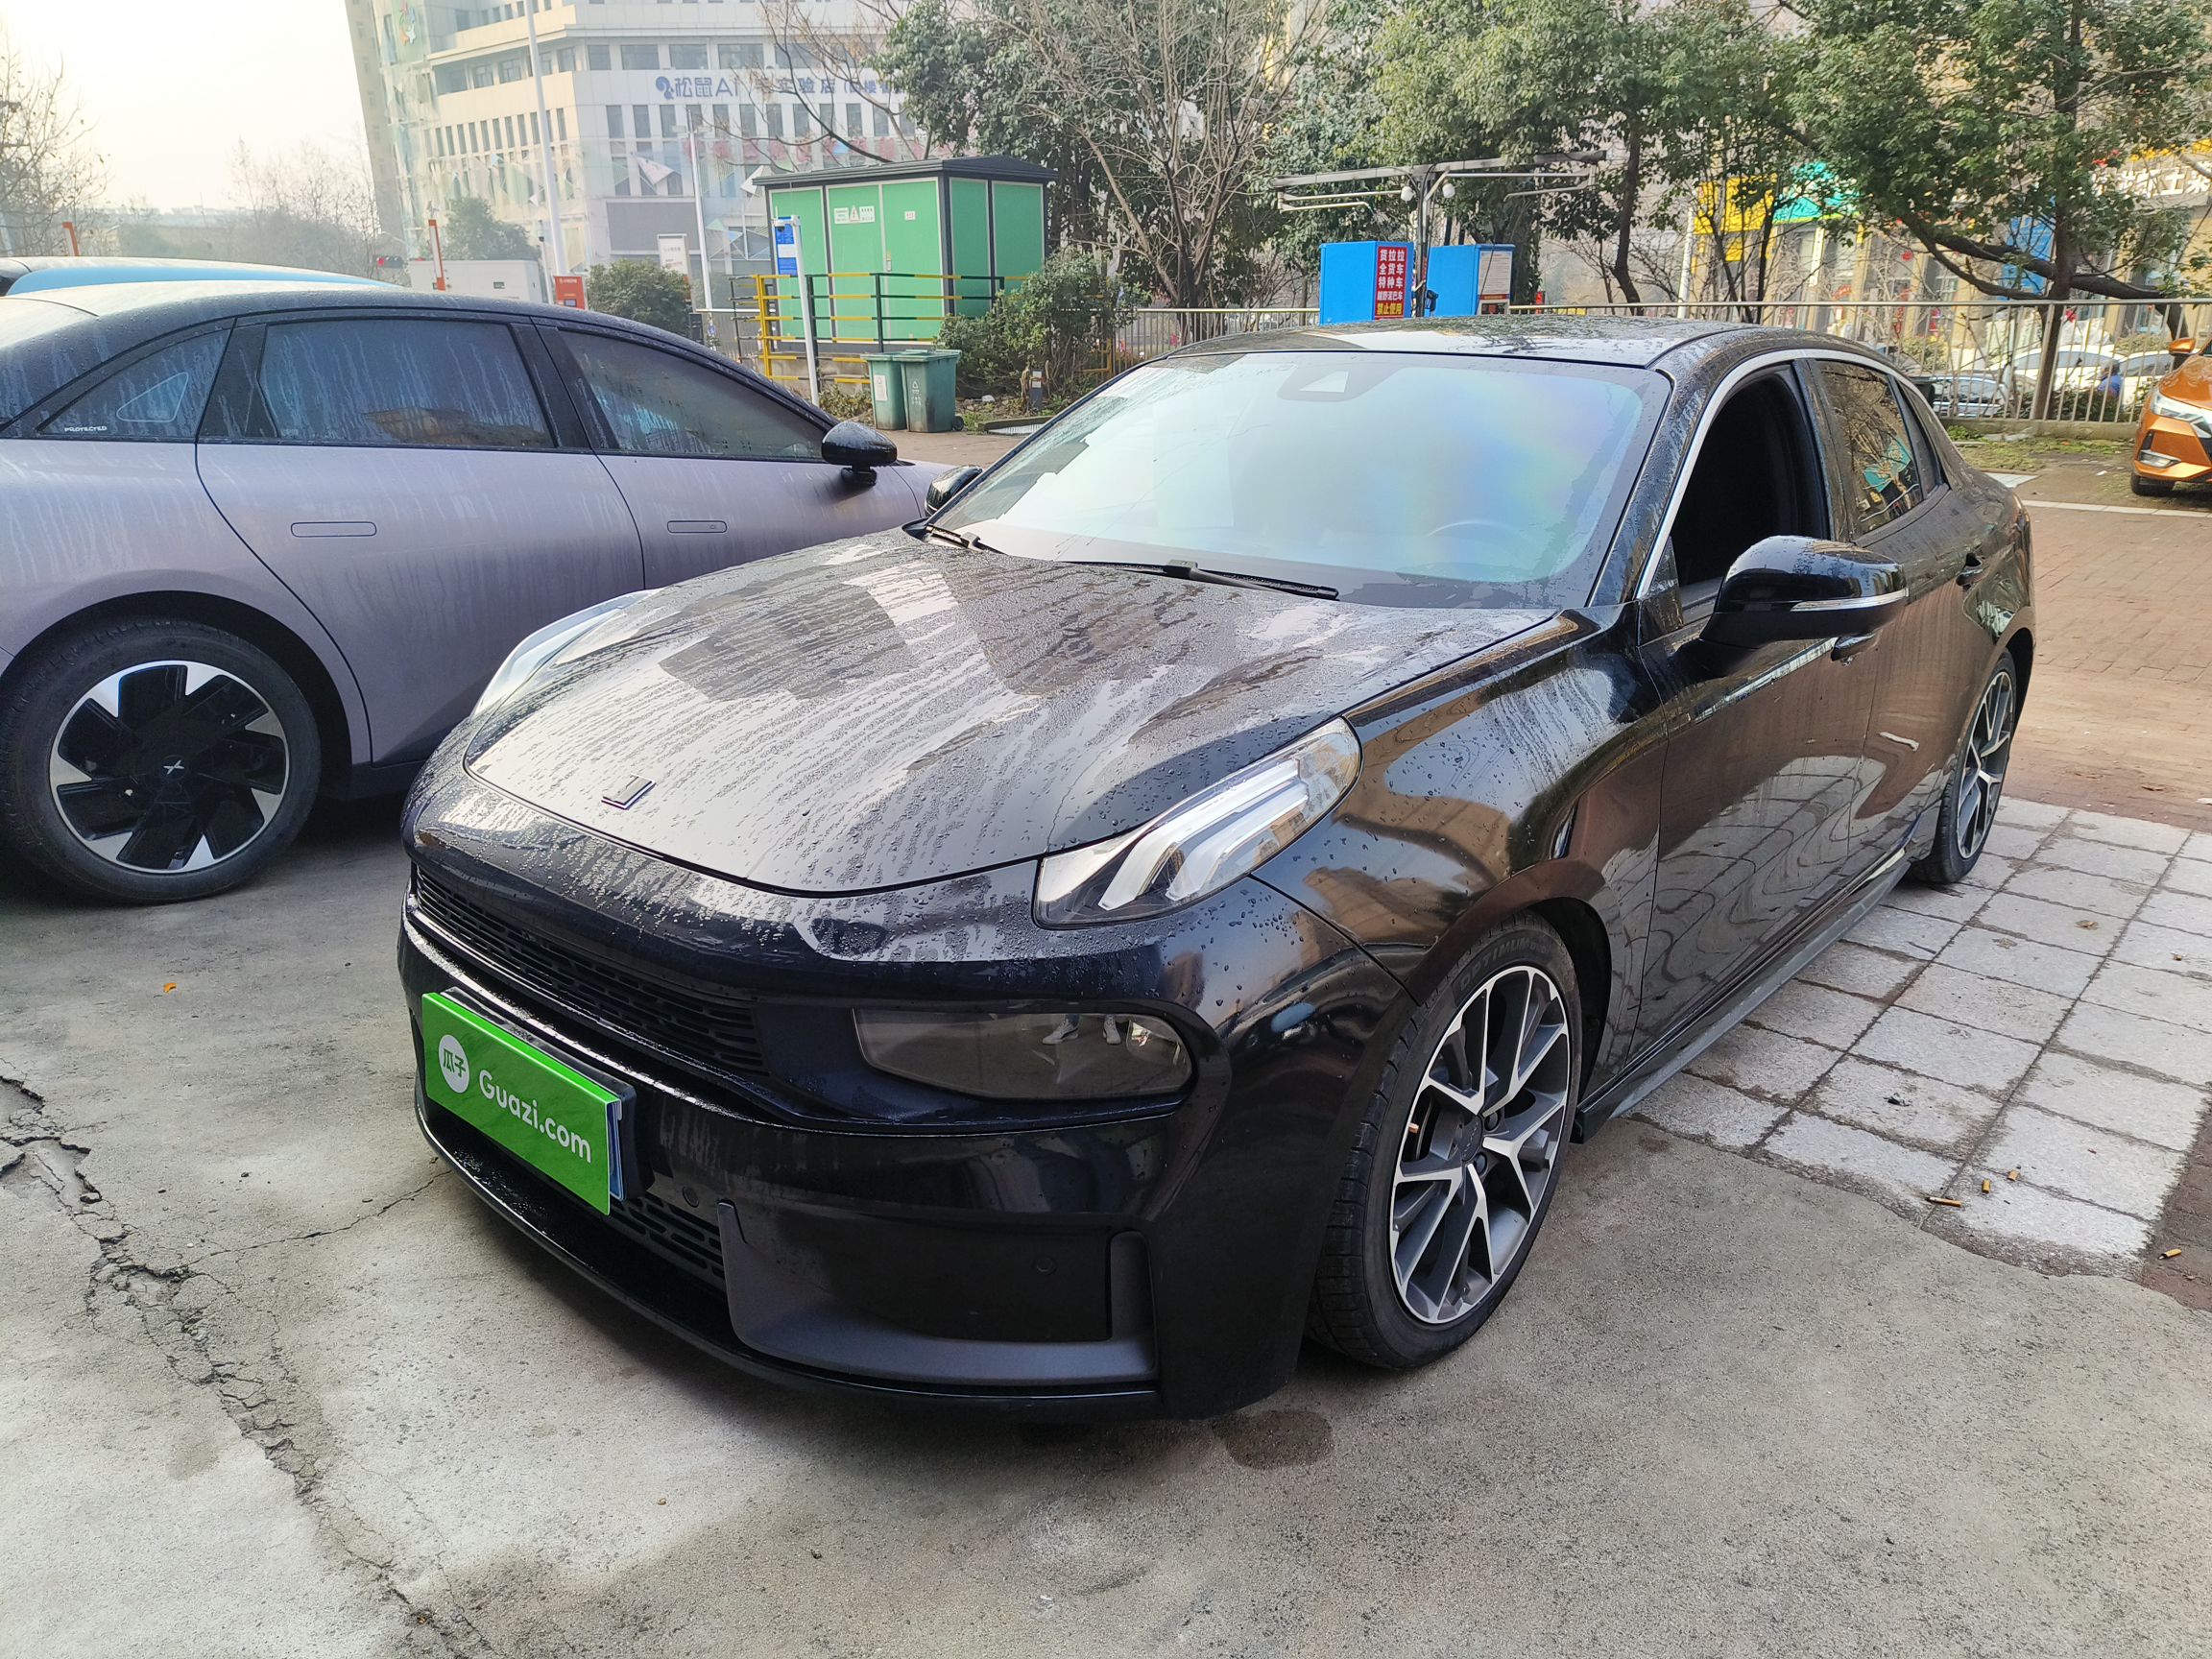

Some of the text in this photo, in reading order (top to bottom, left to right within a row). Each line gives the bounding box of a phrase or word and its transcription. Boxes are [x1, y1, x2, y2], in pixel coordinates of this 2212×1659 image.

[1380, 250, 1405, 261] 货拉拉
[1379, 263, 1404, 276] 全货车
[1378, 276, 1403, 289] 特种车
[1376, 302, 1402, 315] 禁止使用
[443, 1048, 467, 1078] 瓜子
[479, 1070, 591, 1164] Guazi.com
